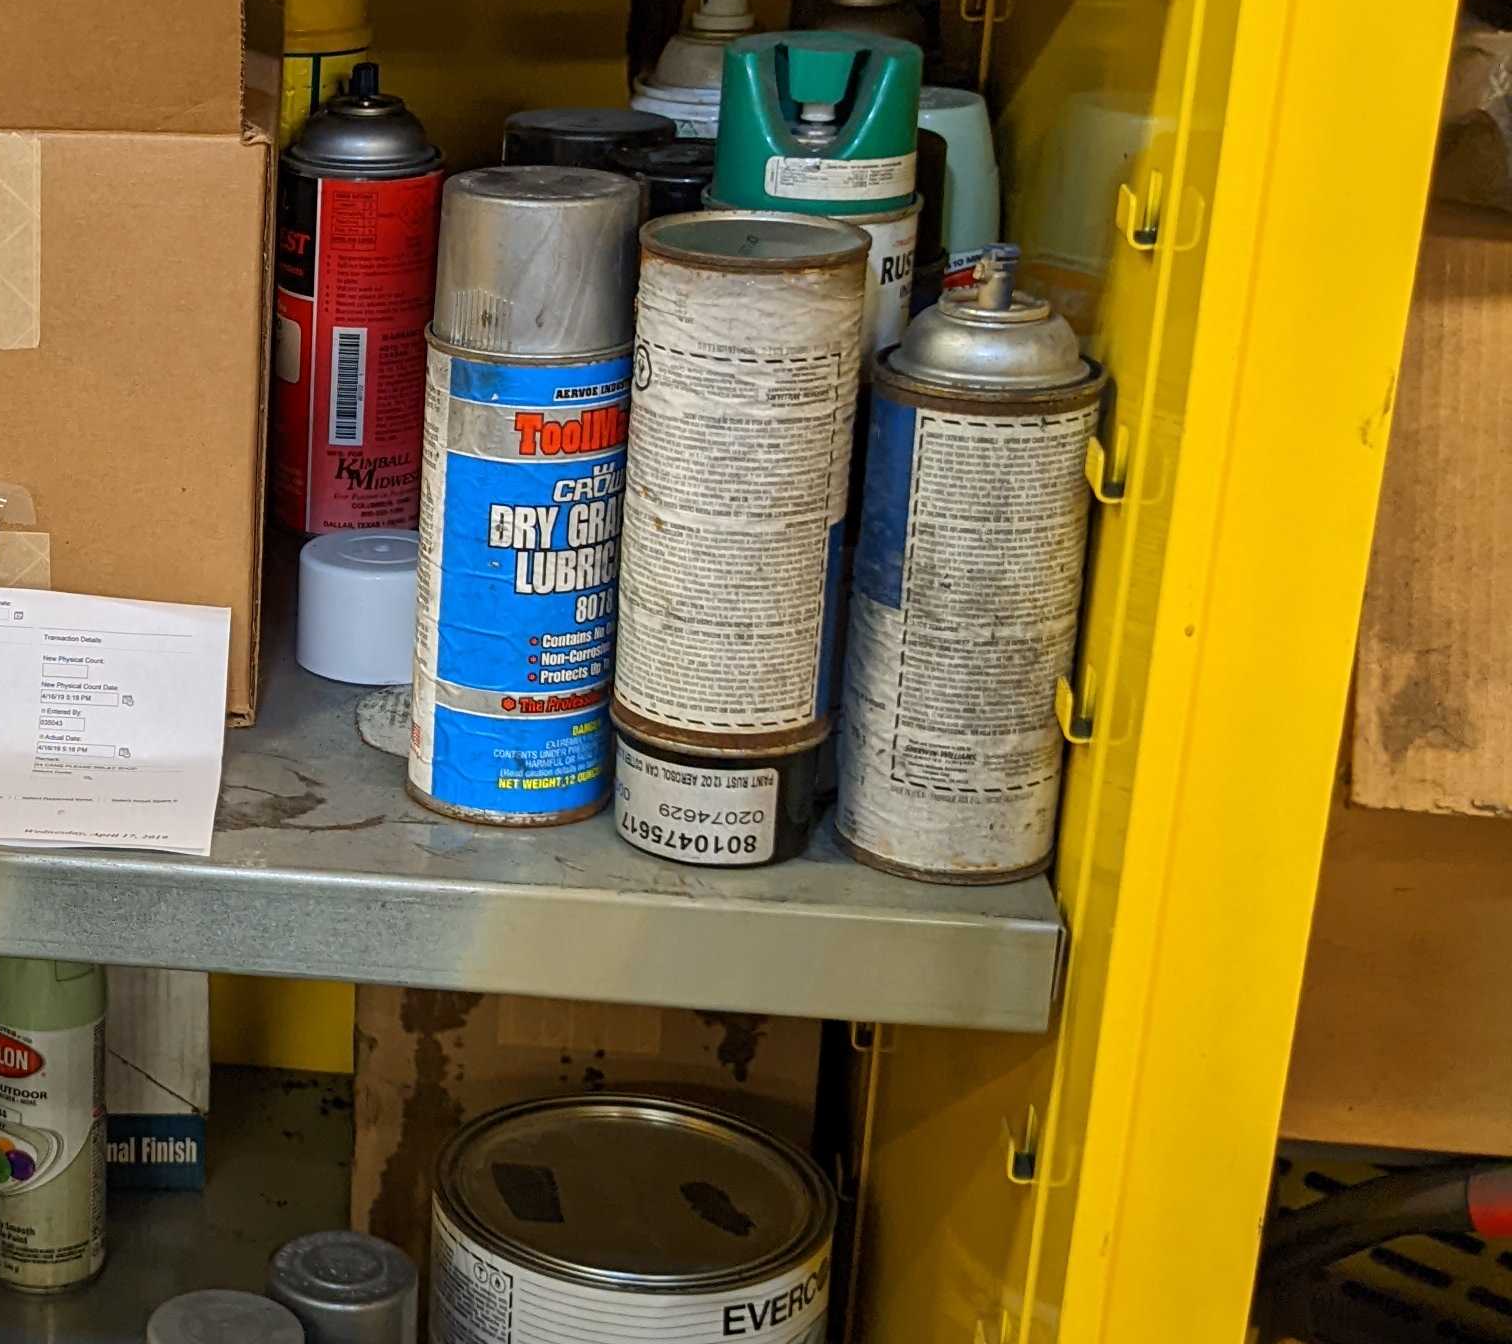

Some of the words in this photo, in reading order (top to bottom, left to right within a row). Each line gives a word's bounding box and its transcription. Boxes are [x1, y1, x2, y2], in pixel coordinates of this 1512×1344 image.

[555, 386, 598, 399] AERVOE
[489, 504, 559, 550] DRY
[543, 631, 592, 648] Contains
[540, 667, 589, 684] Protects
[499, 778, 520, 789] NET
[727, 776, 749, 789] RUST
[659, 803, 764, 825] 02074629
[621, 811, 757, 854] 8010475617
[141, 1138, 197, 1164] Finish
